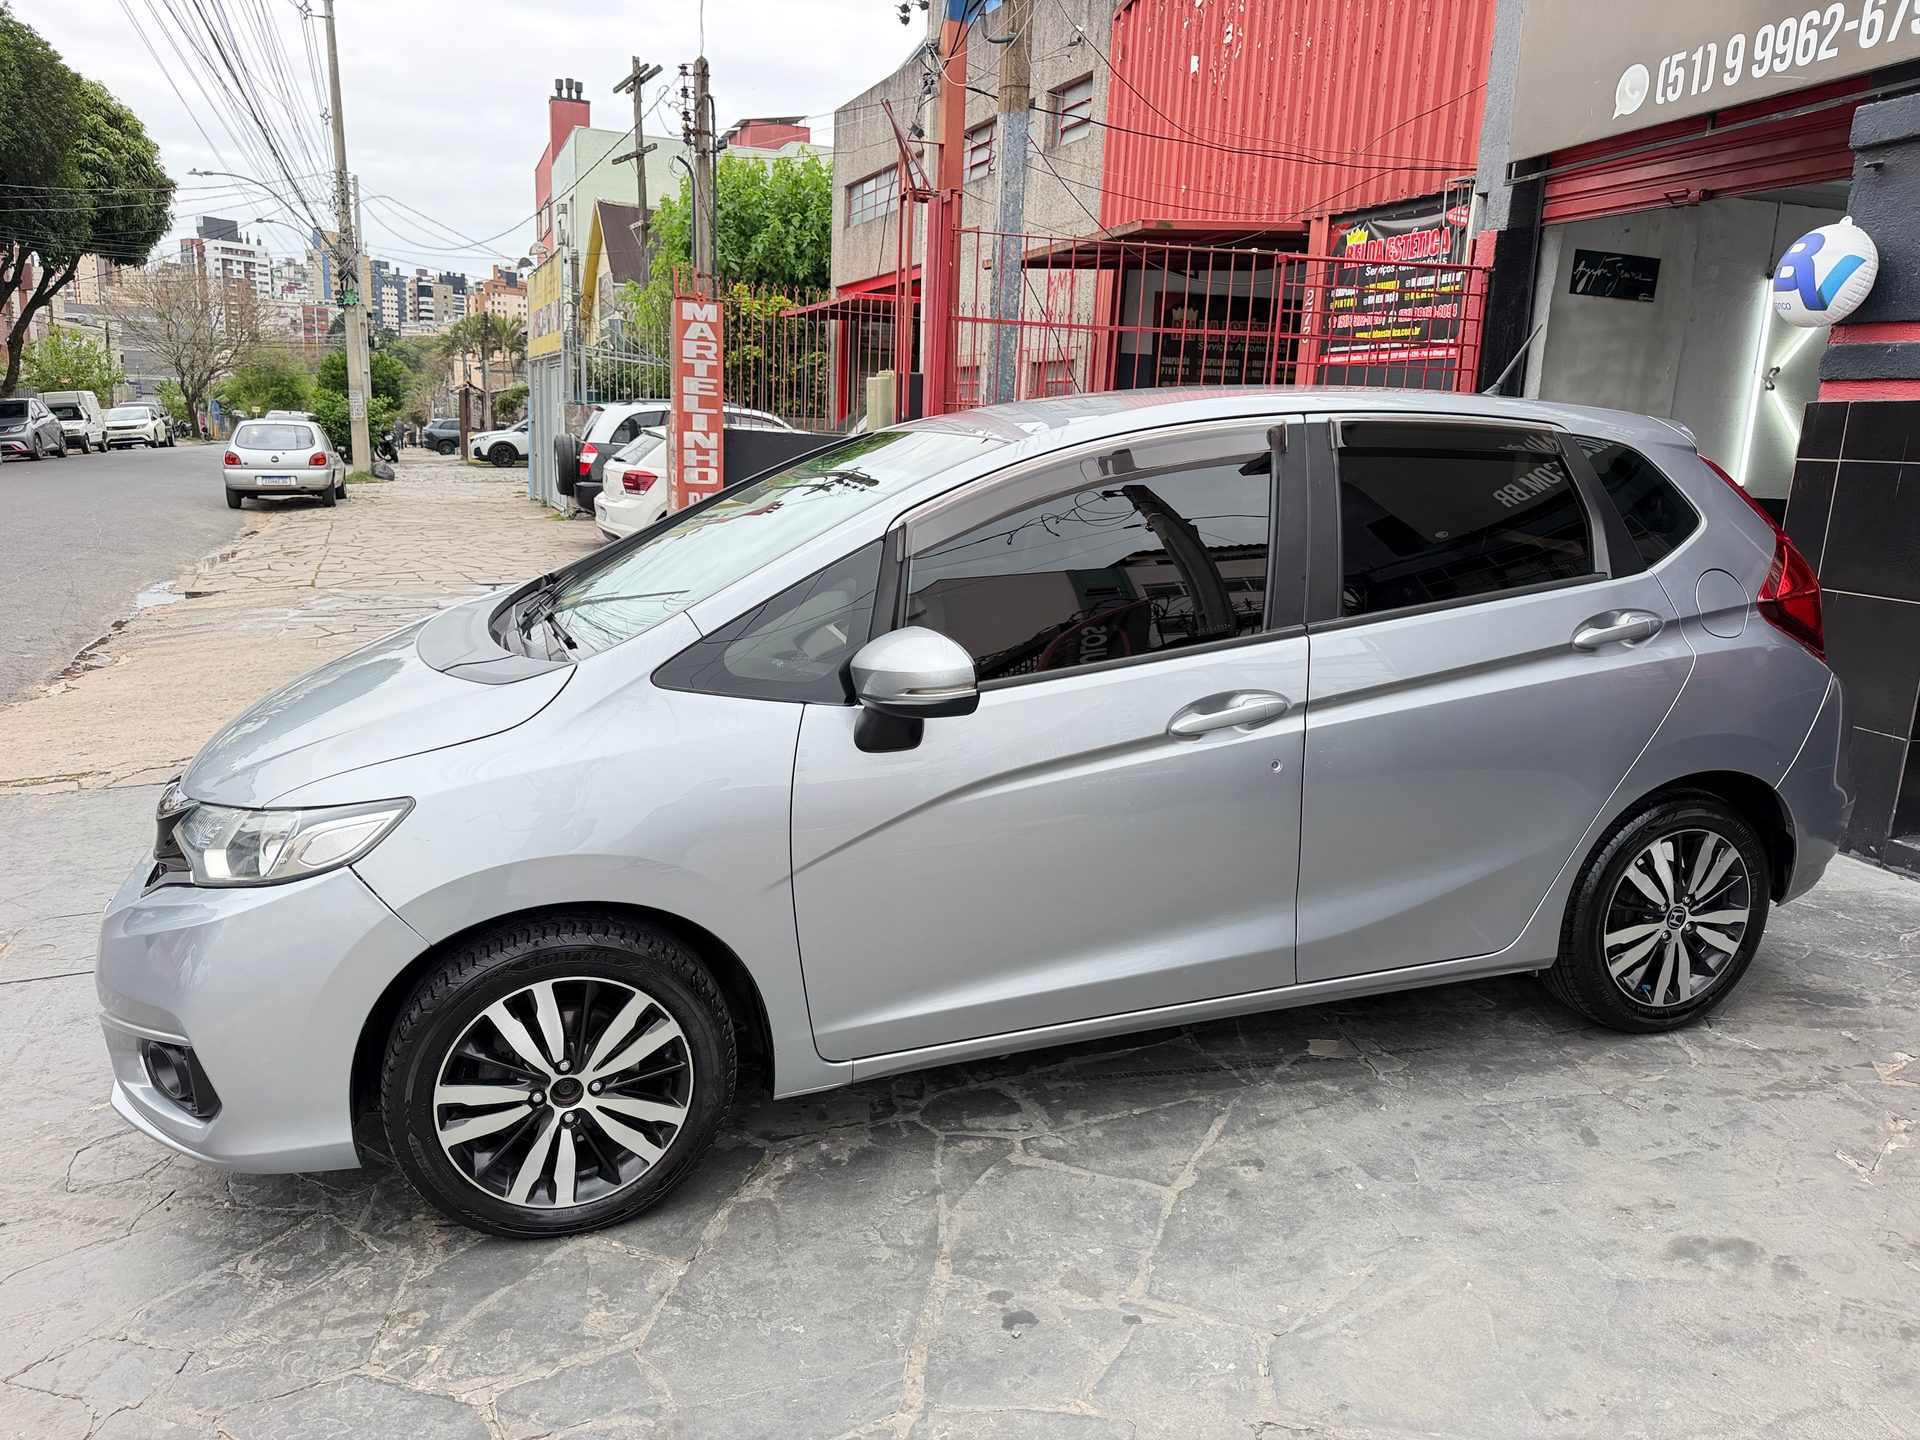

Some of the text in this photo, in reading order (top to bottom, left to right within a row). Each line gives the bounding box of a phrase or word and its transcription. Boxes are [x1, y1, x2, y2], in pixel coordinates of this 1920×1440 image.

[1655, 42, 1718, 105] (51)
[1723, 33, 1746, 87] 9
[682, 302, 718, 485] MARTELINHO
